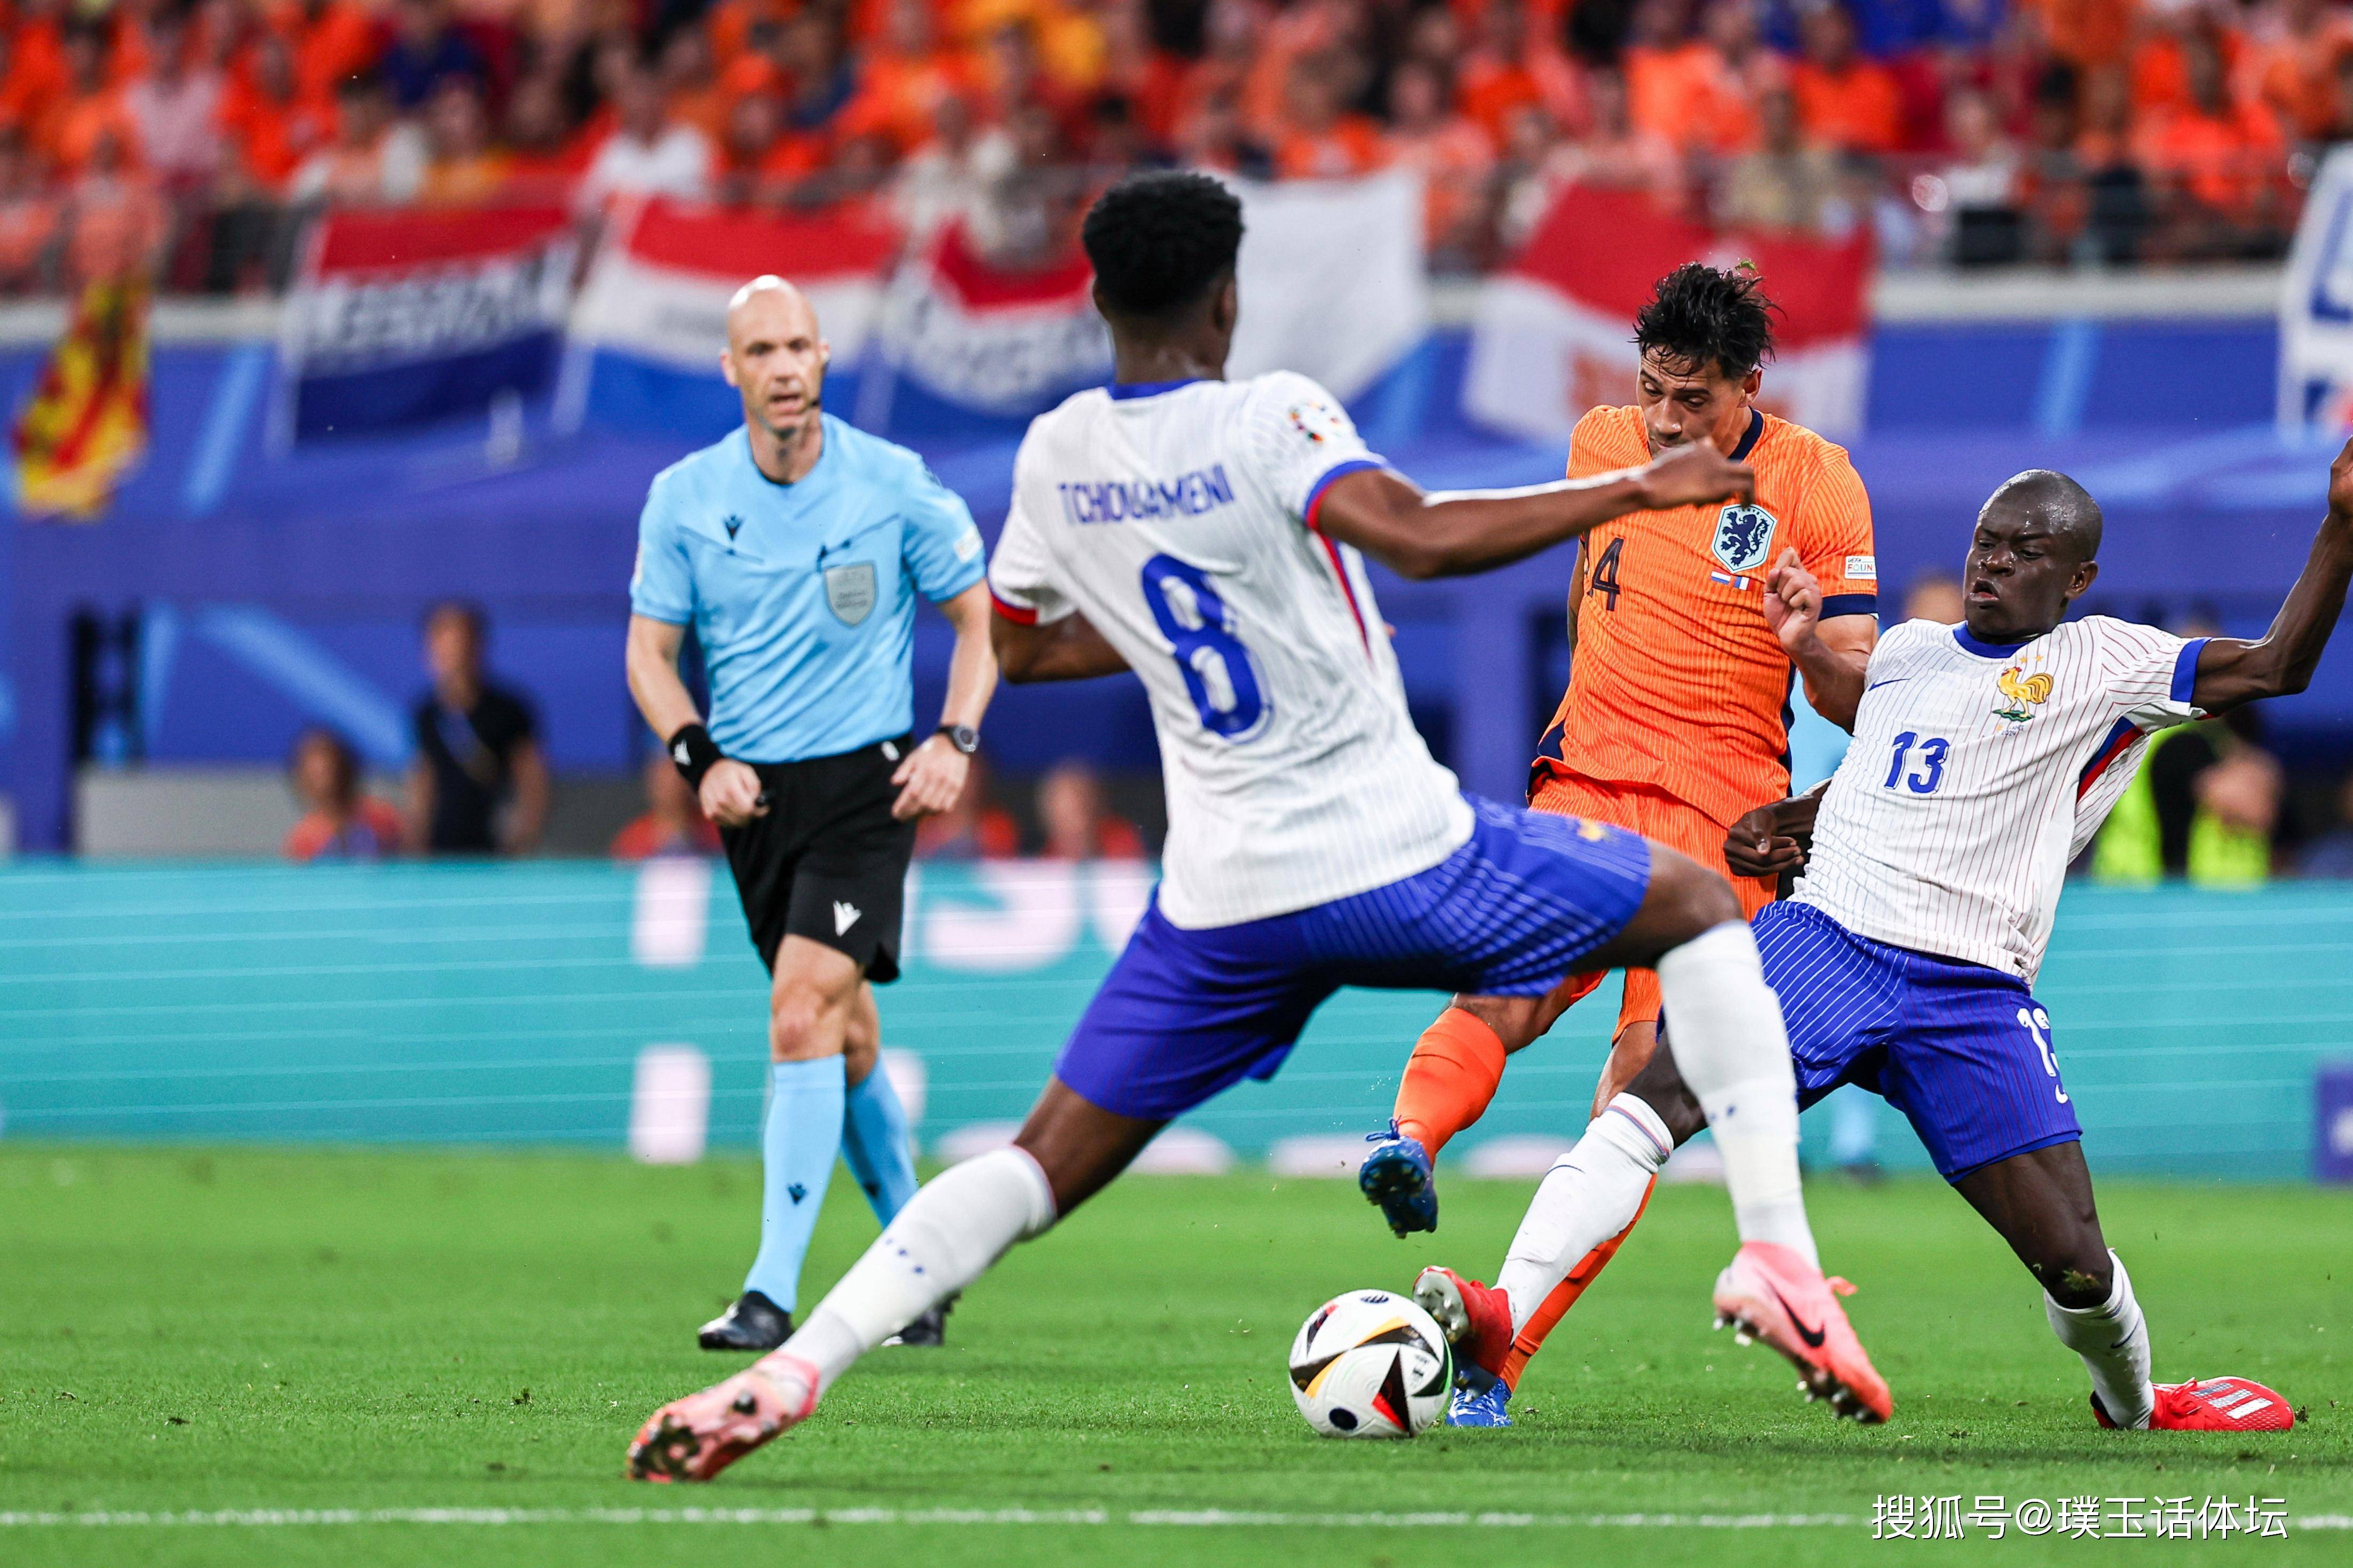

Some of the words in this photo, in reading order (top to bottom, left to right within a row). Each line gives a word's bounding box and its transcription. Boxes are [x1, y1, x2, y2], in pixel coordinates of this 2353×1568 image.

[1587, 537, 1625, 612] 4
[1141, 552, 1274, 744] 8
[1884, 731, 1950, 794] 13
